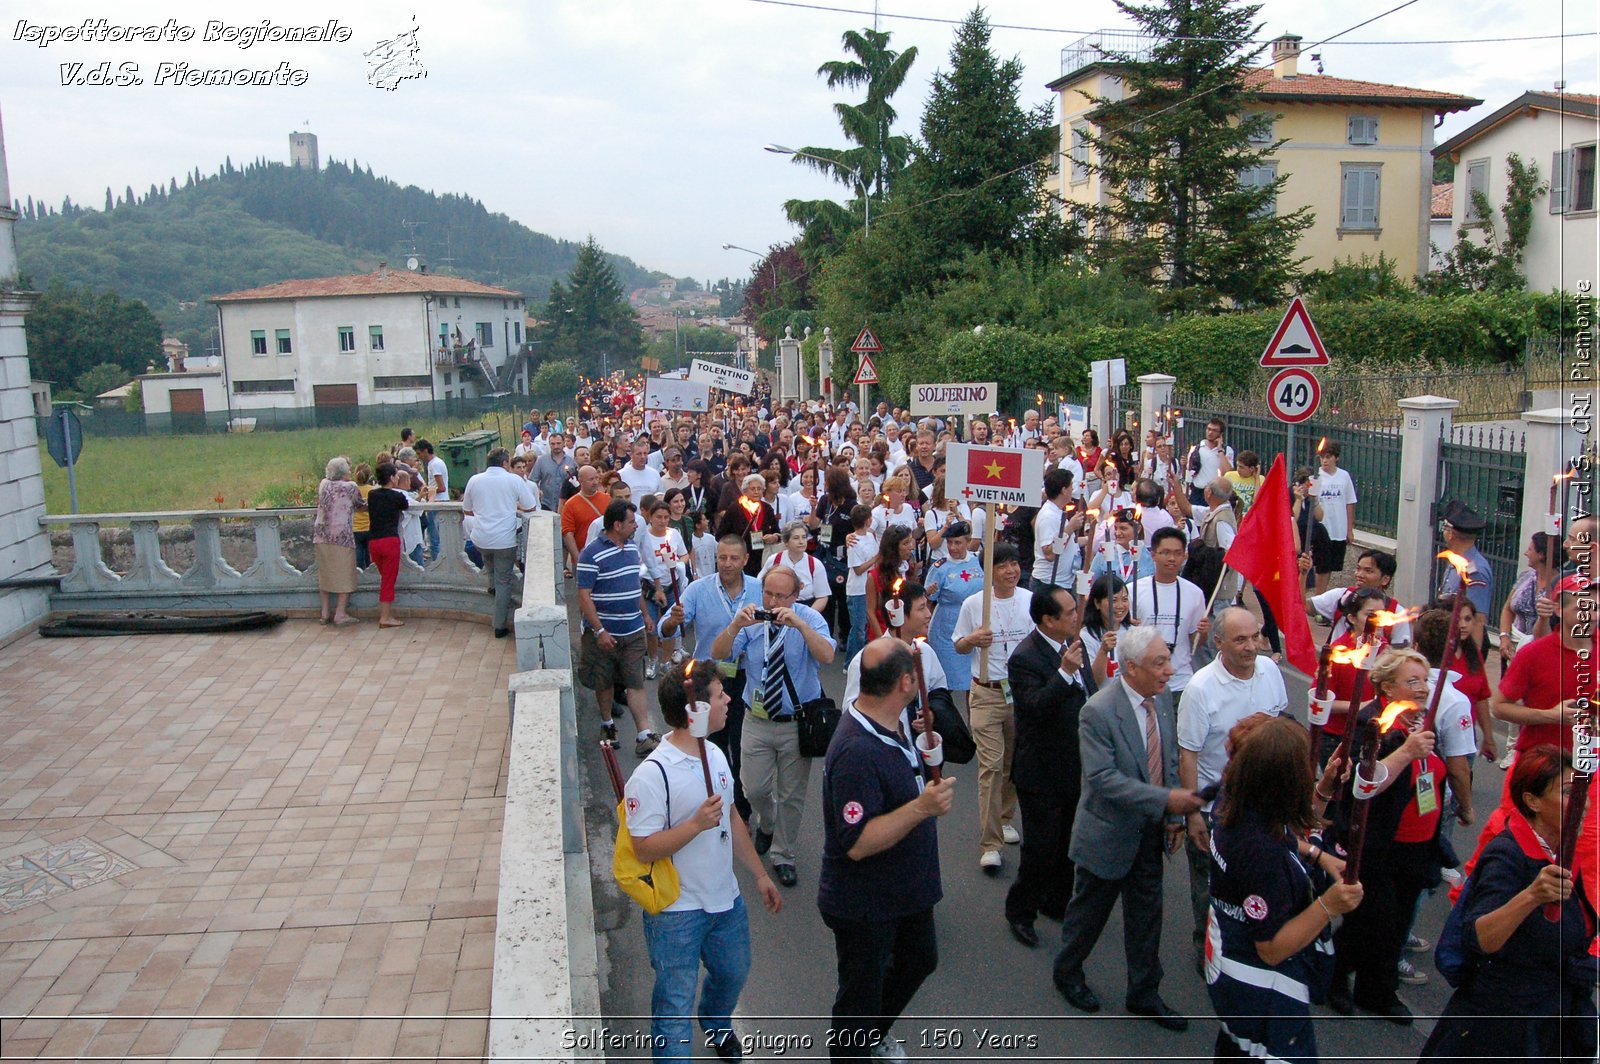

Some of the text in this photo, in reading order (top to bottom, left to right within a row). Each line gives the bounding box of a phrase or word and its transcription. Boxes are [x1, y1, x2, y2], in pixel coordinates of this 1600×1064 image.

[697, 363, 749, 381] TOLENTINO
[918, 386, 988, 402] SOLFERINO
[1279, 383, 1308, 408] 40
[976, 488, 1026, 503] VIET NAM
